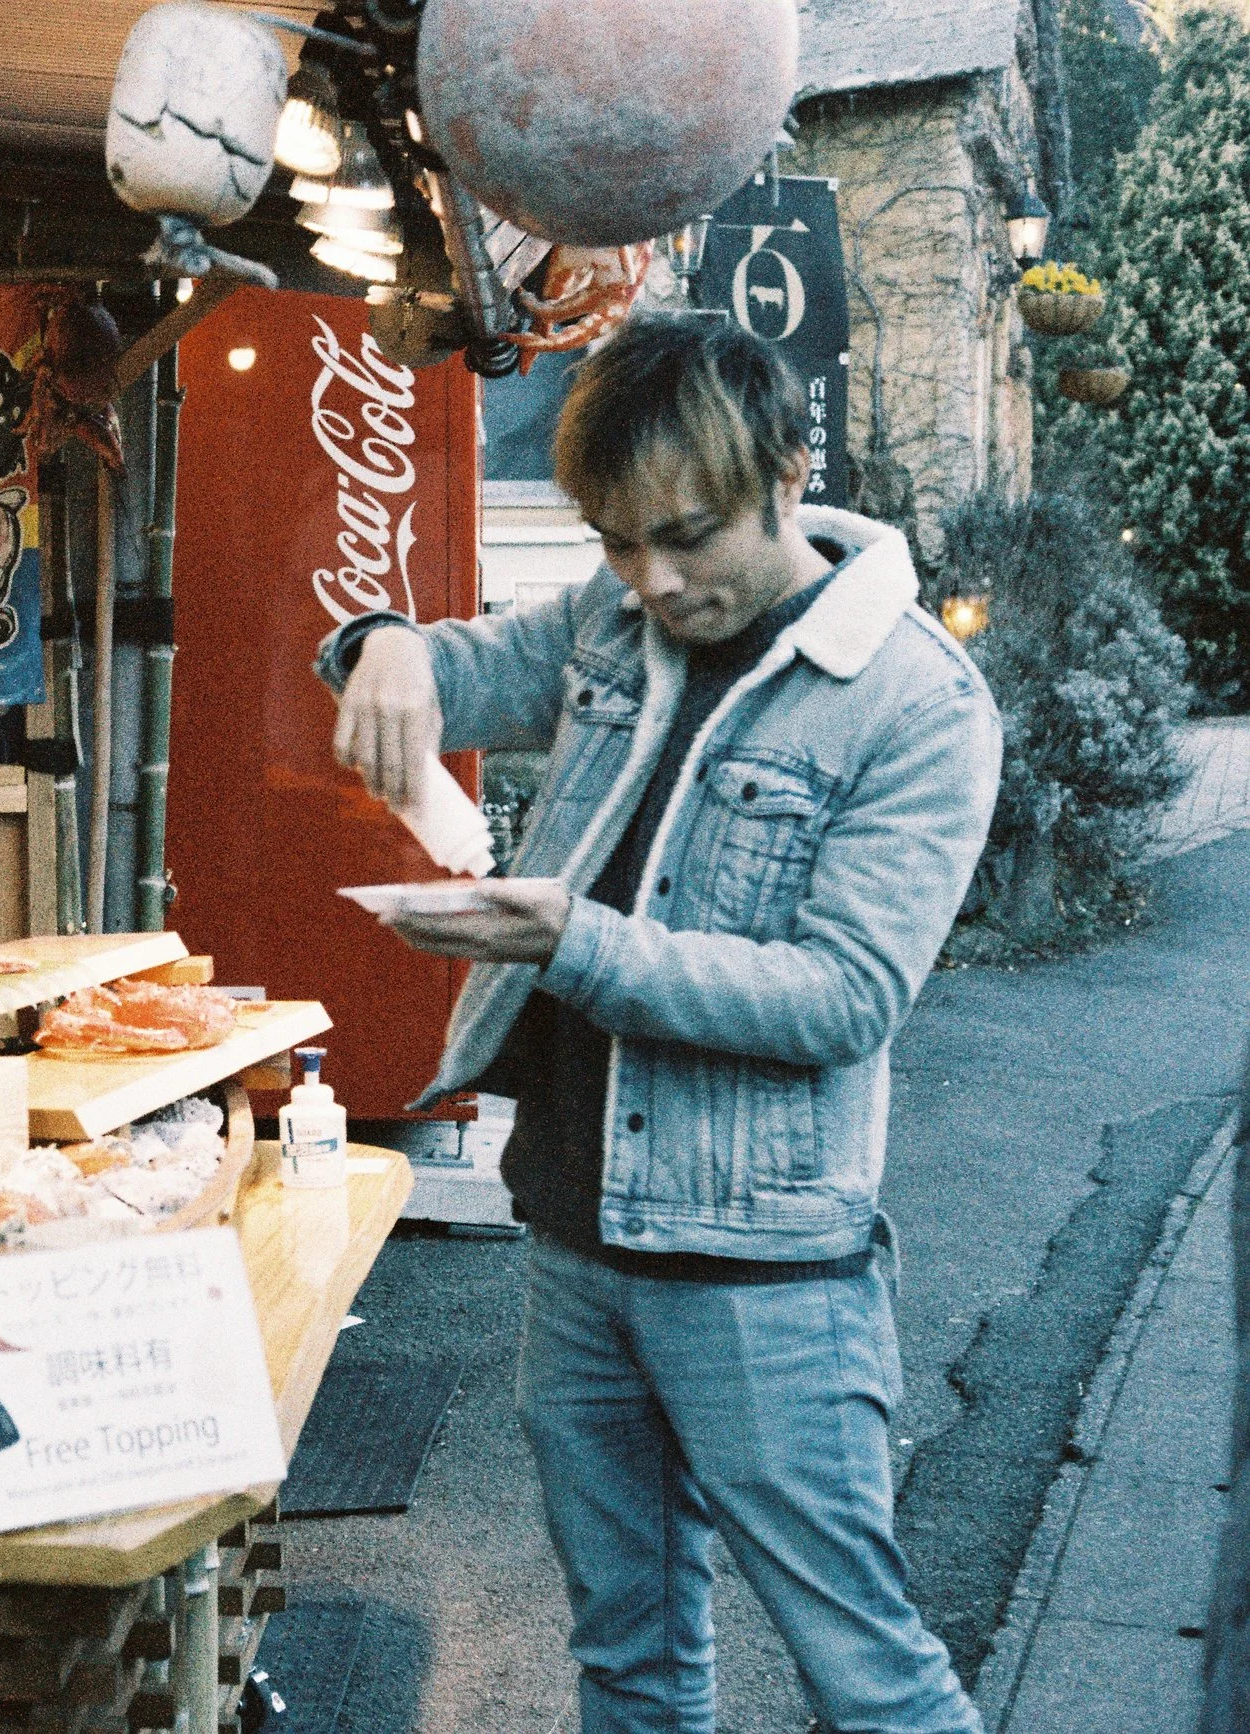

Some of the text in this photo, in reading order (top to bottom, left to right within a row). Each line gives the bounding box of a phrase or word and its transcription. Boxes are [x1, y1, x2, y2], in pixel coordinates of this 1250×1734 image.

[45, 1337, 173, 1388] 調味料有
[24, 1413, 221, 1469] Free Topping
